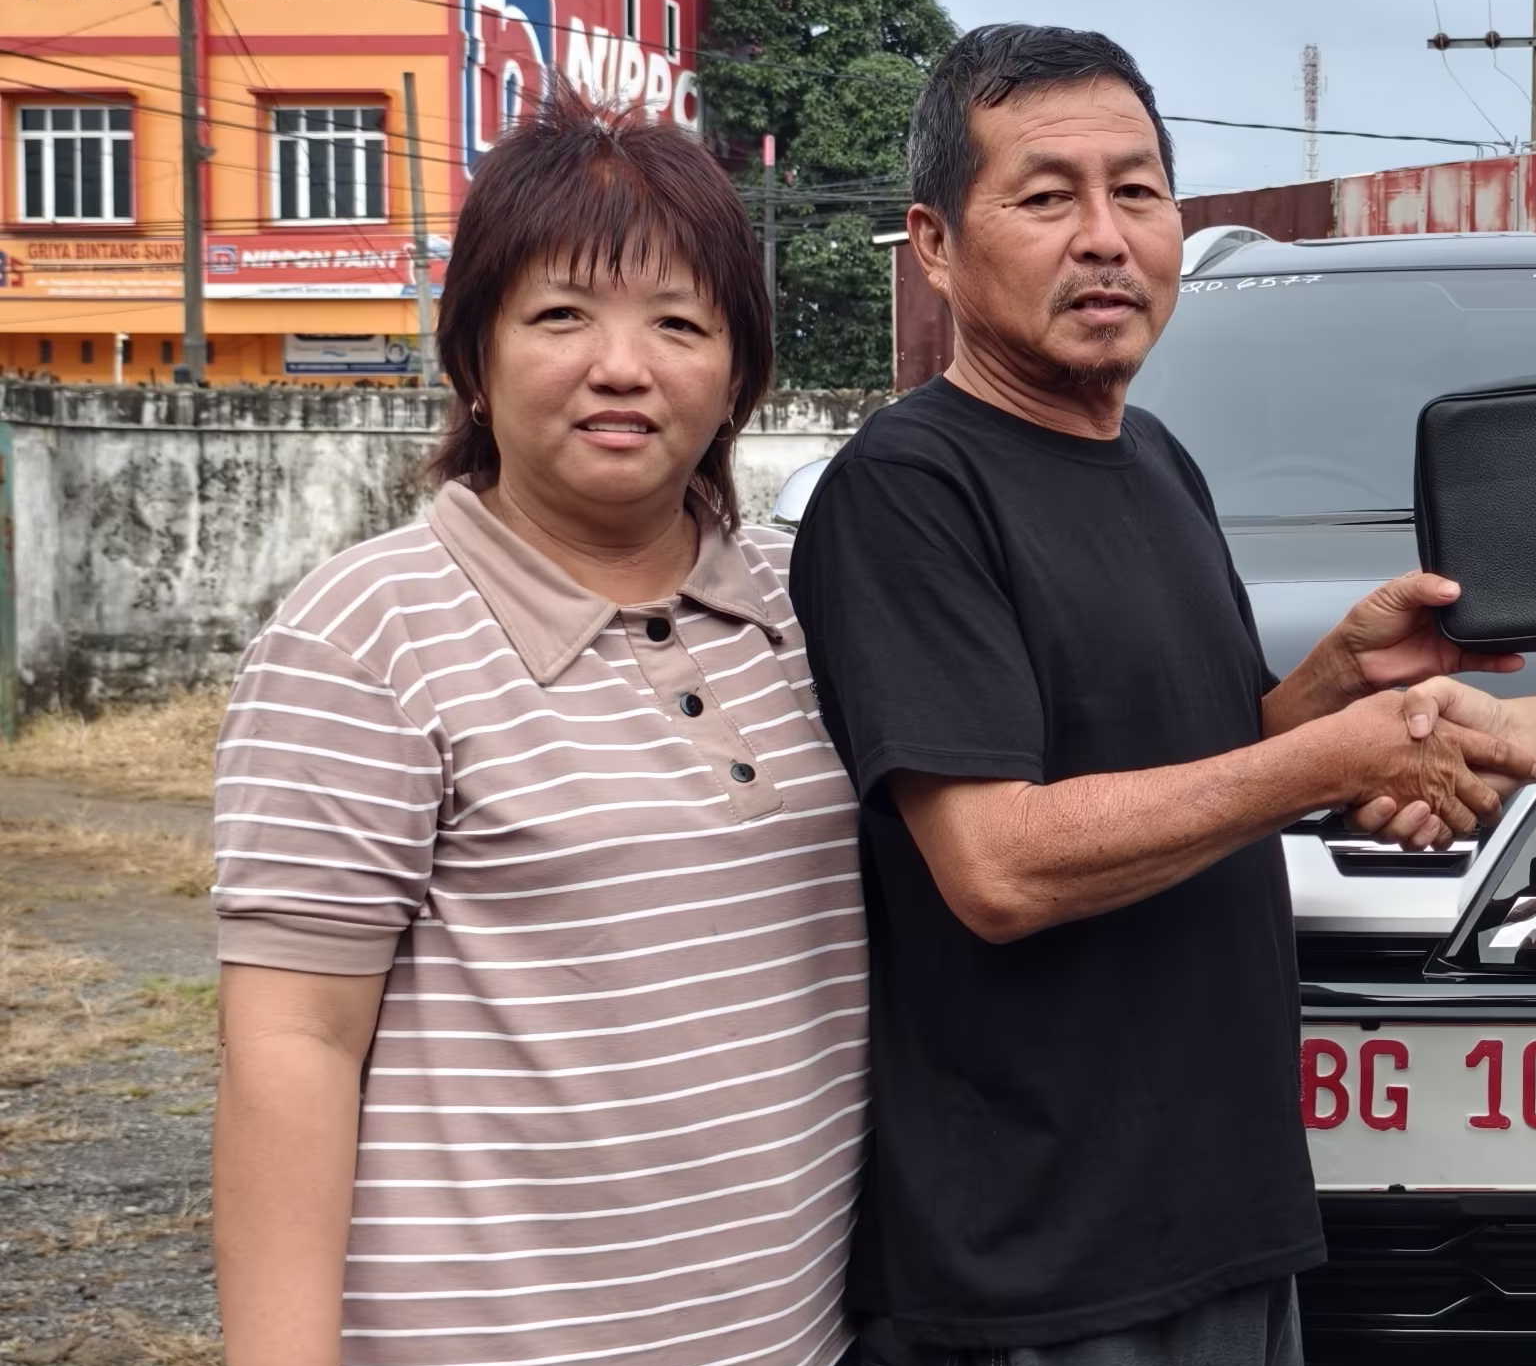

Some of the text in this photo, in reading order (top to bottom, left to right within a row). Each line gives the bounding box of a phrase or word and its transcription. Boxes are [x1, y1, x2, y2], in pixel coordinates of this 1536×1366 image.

[27, 242, 186, 262] GRIYA BINTANG SURY
[241, 249, 399, 269] NIPPON PAINT
[1300, 1038, 1409, 1131] BG
